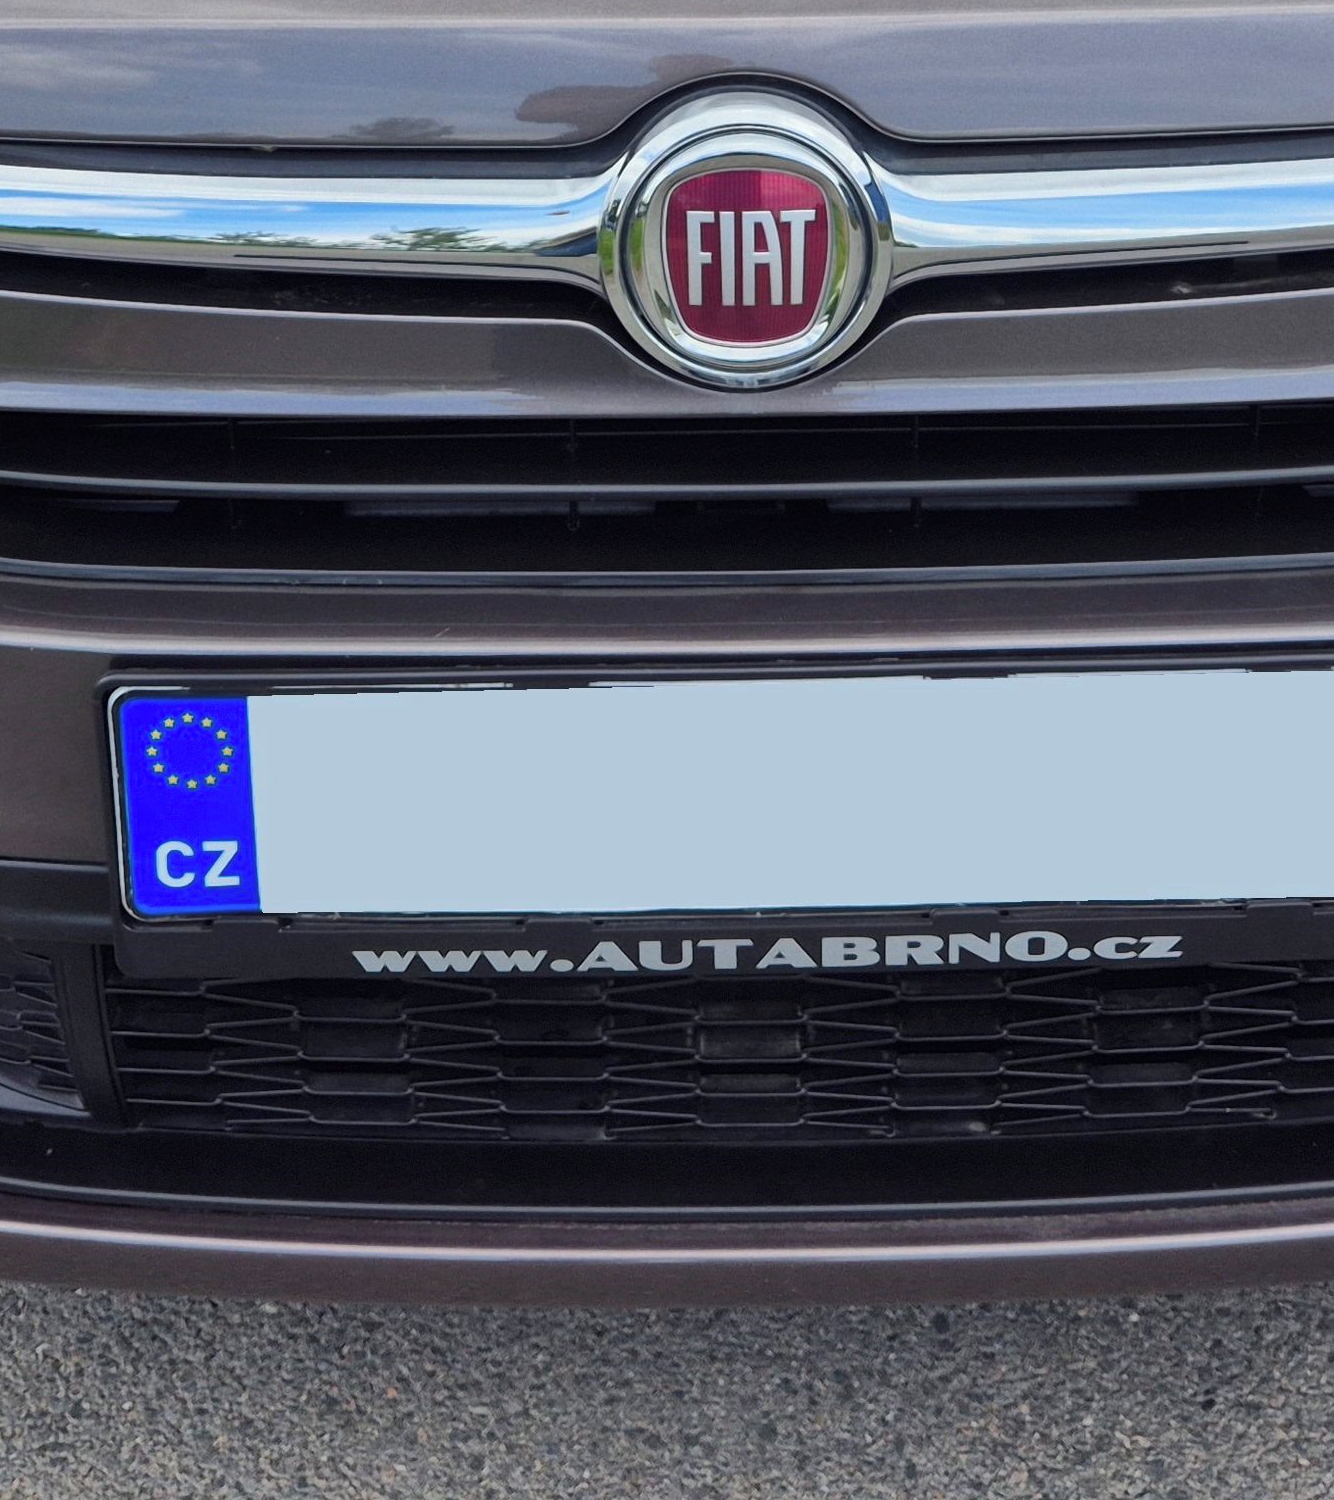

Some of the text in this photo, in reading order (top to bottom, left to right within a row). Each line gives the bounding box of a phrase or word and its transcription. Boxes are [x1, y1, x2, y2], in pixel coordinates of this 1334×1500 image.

[685, 209, 816, 306] FIAT
[155, 840, 241, 888] CZ
[351, 930, 1184, 972] www.AUTABRNO.cz
